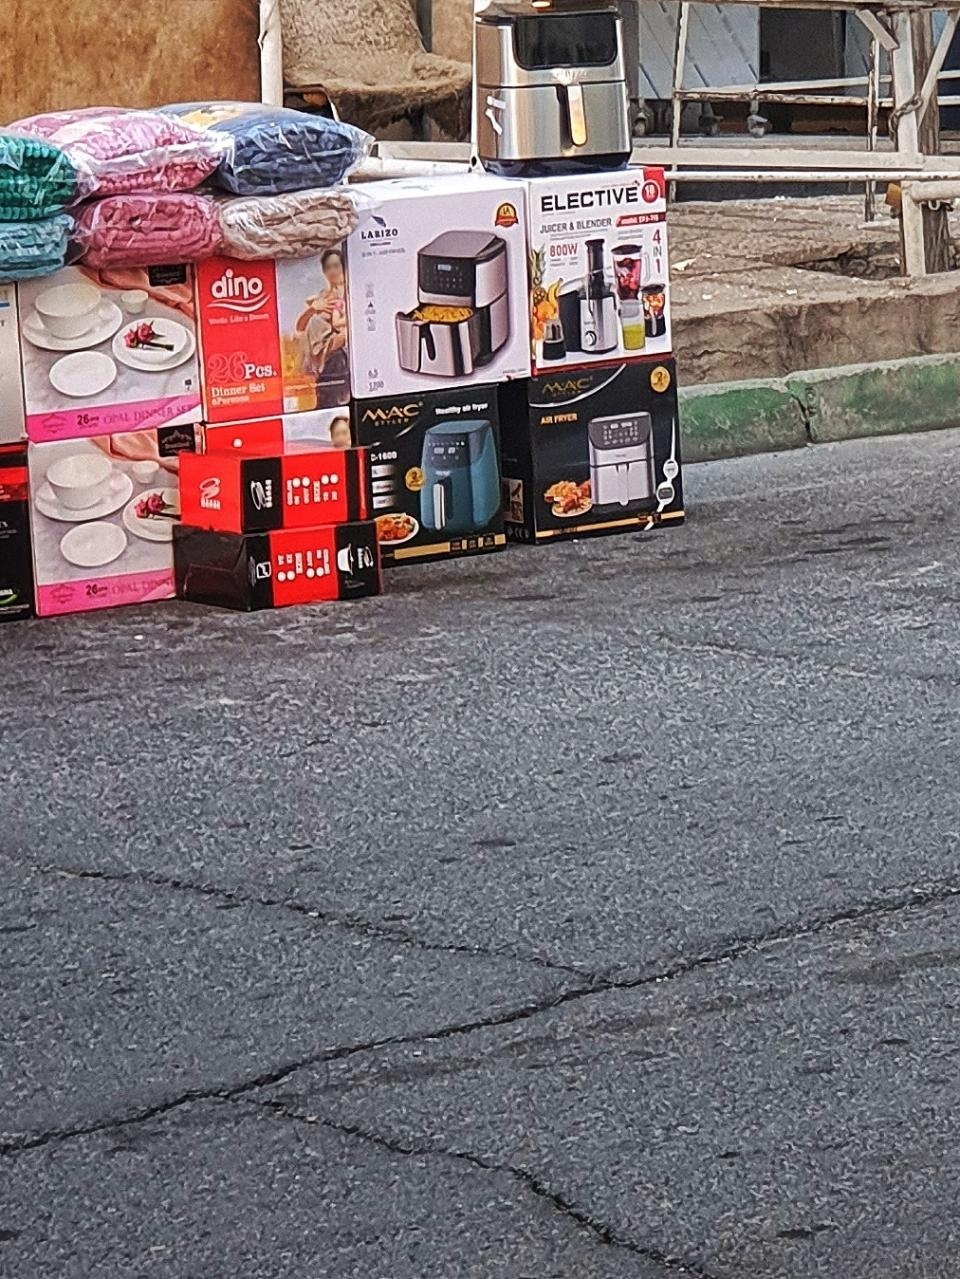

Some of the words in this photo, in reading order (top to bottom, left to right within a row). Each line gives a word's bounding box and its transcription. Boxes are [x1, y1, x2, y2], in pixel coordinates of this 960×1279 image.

[541, 186, 639, 212] ELECTIVE
[540, 222, 567, 234] JUICER
[569, 221, 575, 231] &
[576, 217, 613, 230] BLENDER
[652, 229, 662, 245] 4
[550, 242, 579, 258] 800W
[653, 245, 663, 257] IN
[211, 268, 263, 299] dino
[207, 351, 248, 385] 26
[211, 385, 247, 398] Dinner
[249, 382, 266, 393] Set
[77, 414, 90, 426] 26
[541, 415, 553, 424] AIR
[554, 412, 578, 423] FRYER
[86, 584, 98, 595] 26
